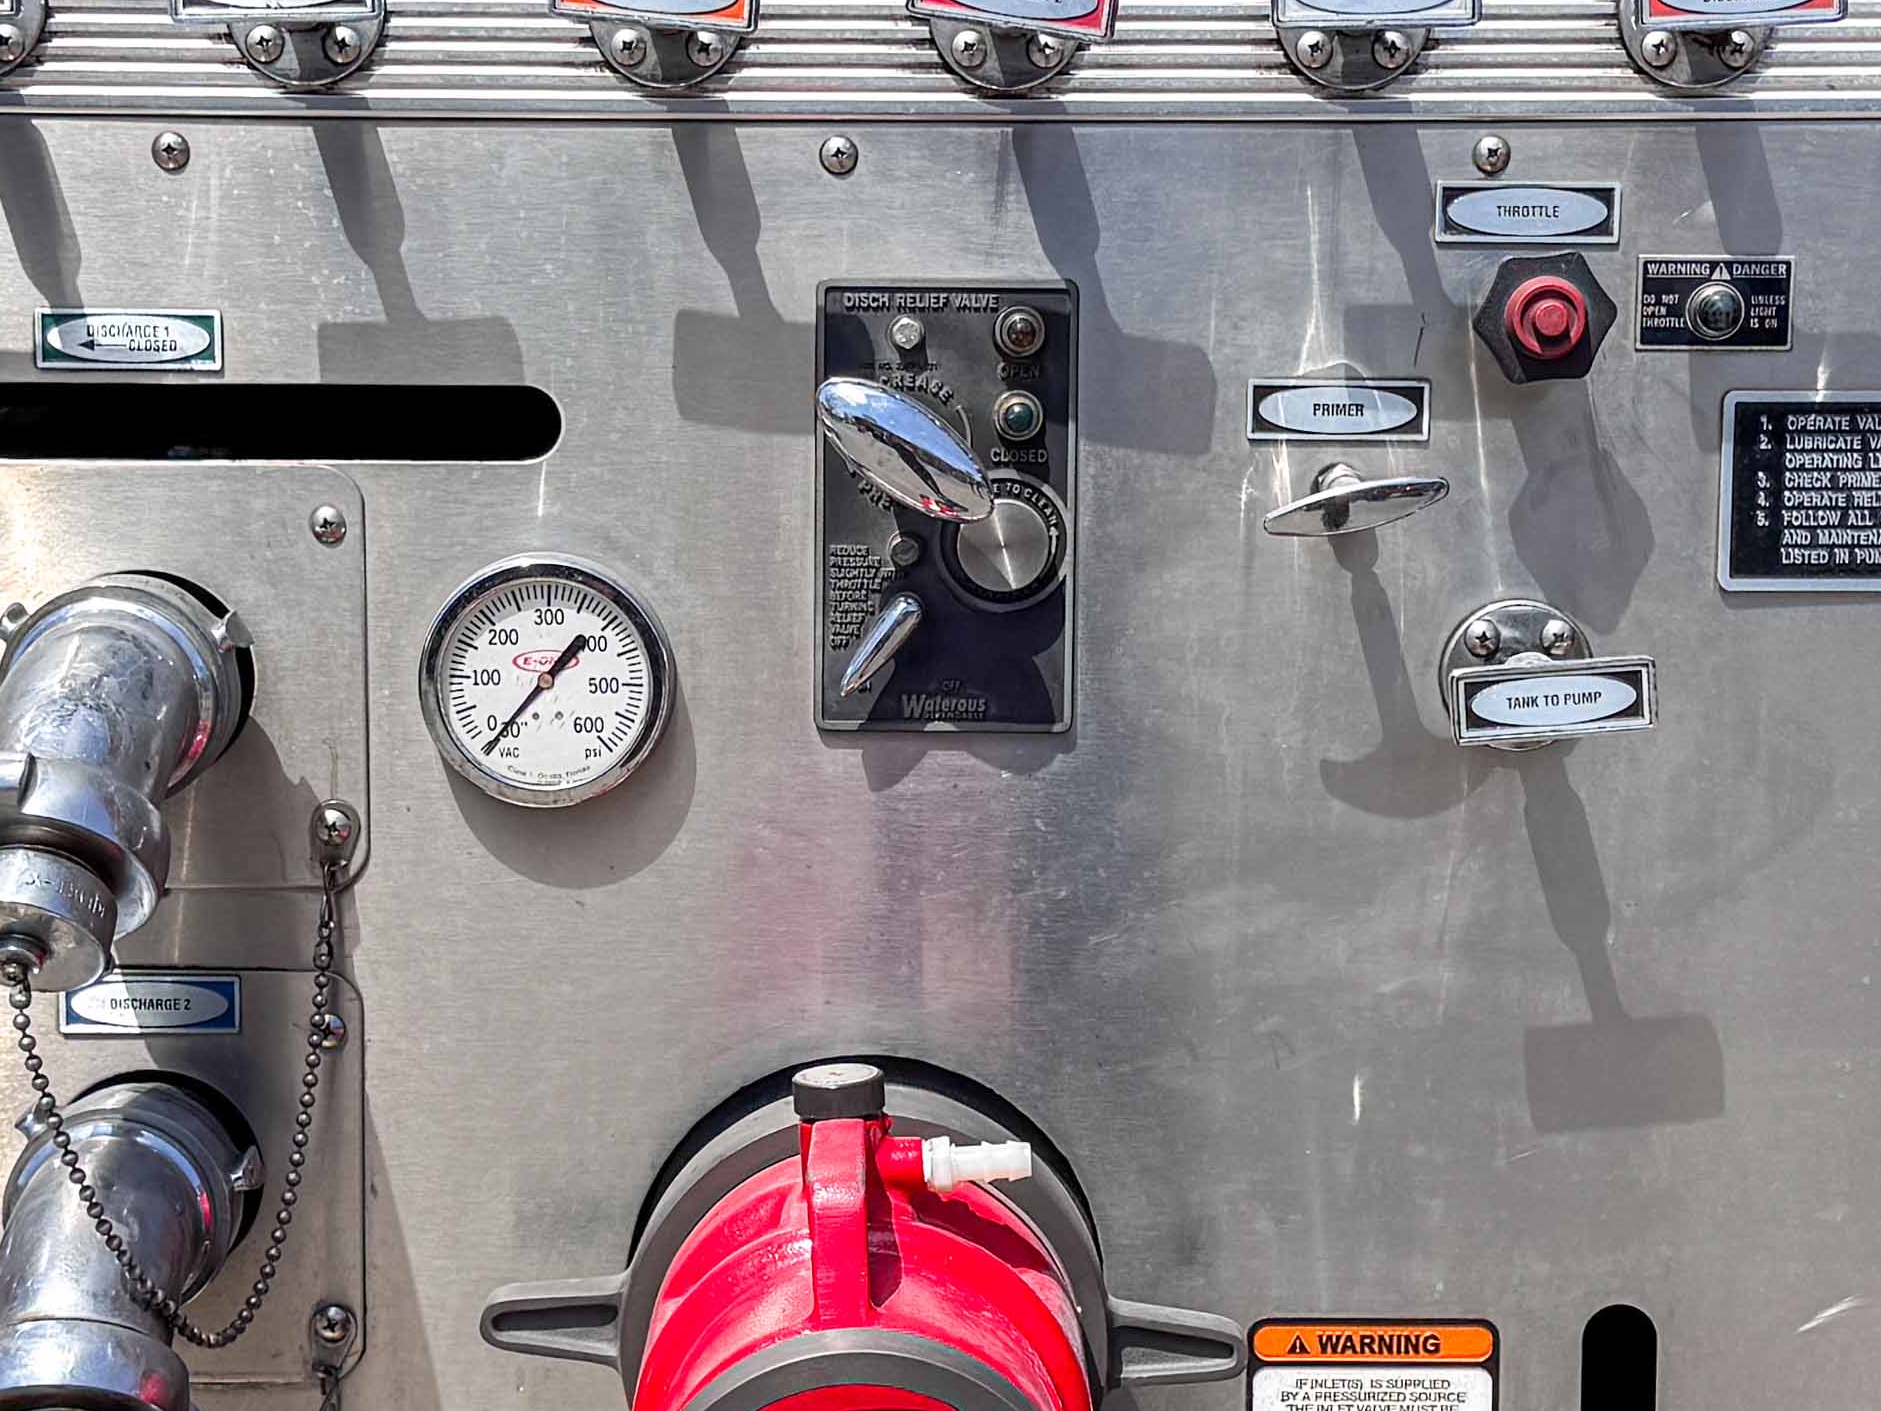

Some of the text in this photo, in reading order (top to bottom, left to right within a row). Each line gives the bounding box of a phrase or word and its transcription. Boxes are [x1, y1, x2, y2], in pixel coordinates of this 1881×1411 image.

[1496, 205, 1560, 218] THROTTLE
[1646, 262, 1710, 276] WARNING
[1732, 262, 1787, 276] DANGER
[843, 293, 999, 309] DISCH RELIEF VALVE
[86, 324, 163, 338] DISCHARGE
[128, 339, 177, 352] CLOSED
[1312, 403, 1365, 417] PRIMER
[1786, 415, 1850, 431] OPERATE
[1785, 435, 1862, 450] LUBRICATE
[990, 448, 1048, 463] CLOSED
[1785, 454, 1862, 469] OPERATING
[1005, 481, 1057, 525] TO CLEAN
[534, 608, 565, 626] 300
[587, 677, 620, 695] 500
[1505, 691, 1602, 711] TANK TO PUMP
[110, 998, 192, 1011] DISCHARGE 2
[1316, 1334, 1441, 1354] WARNING
[1295, 1378, 1309, 1390] IF
[1370, 1378, 1383, 1389] IS
[1386, 1378, 1451, 1390] SUPPLIED
